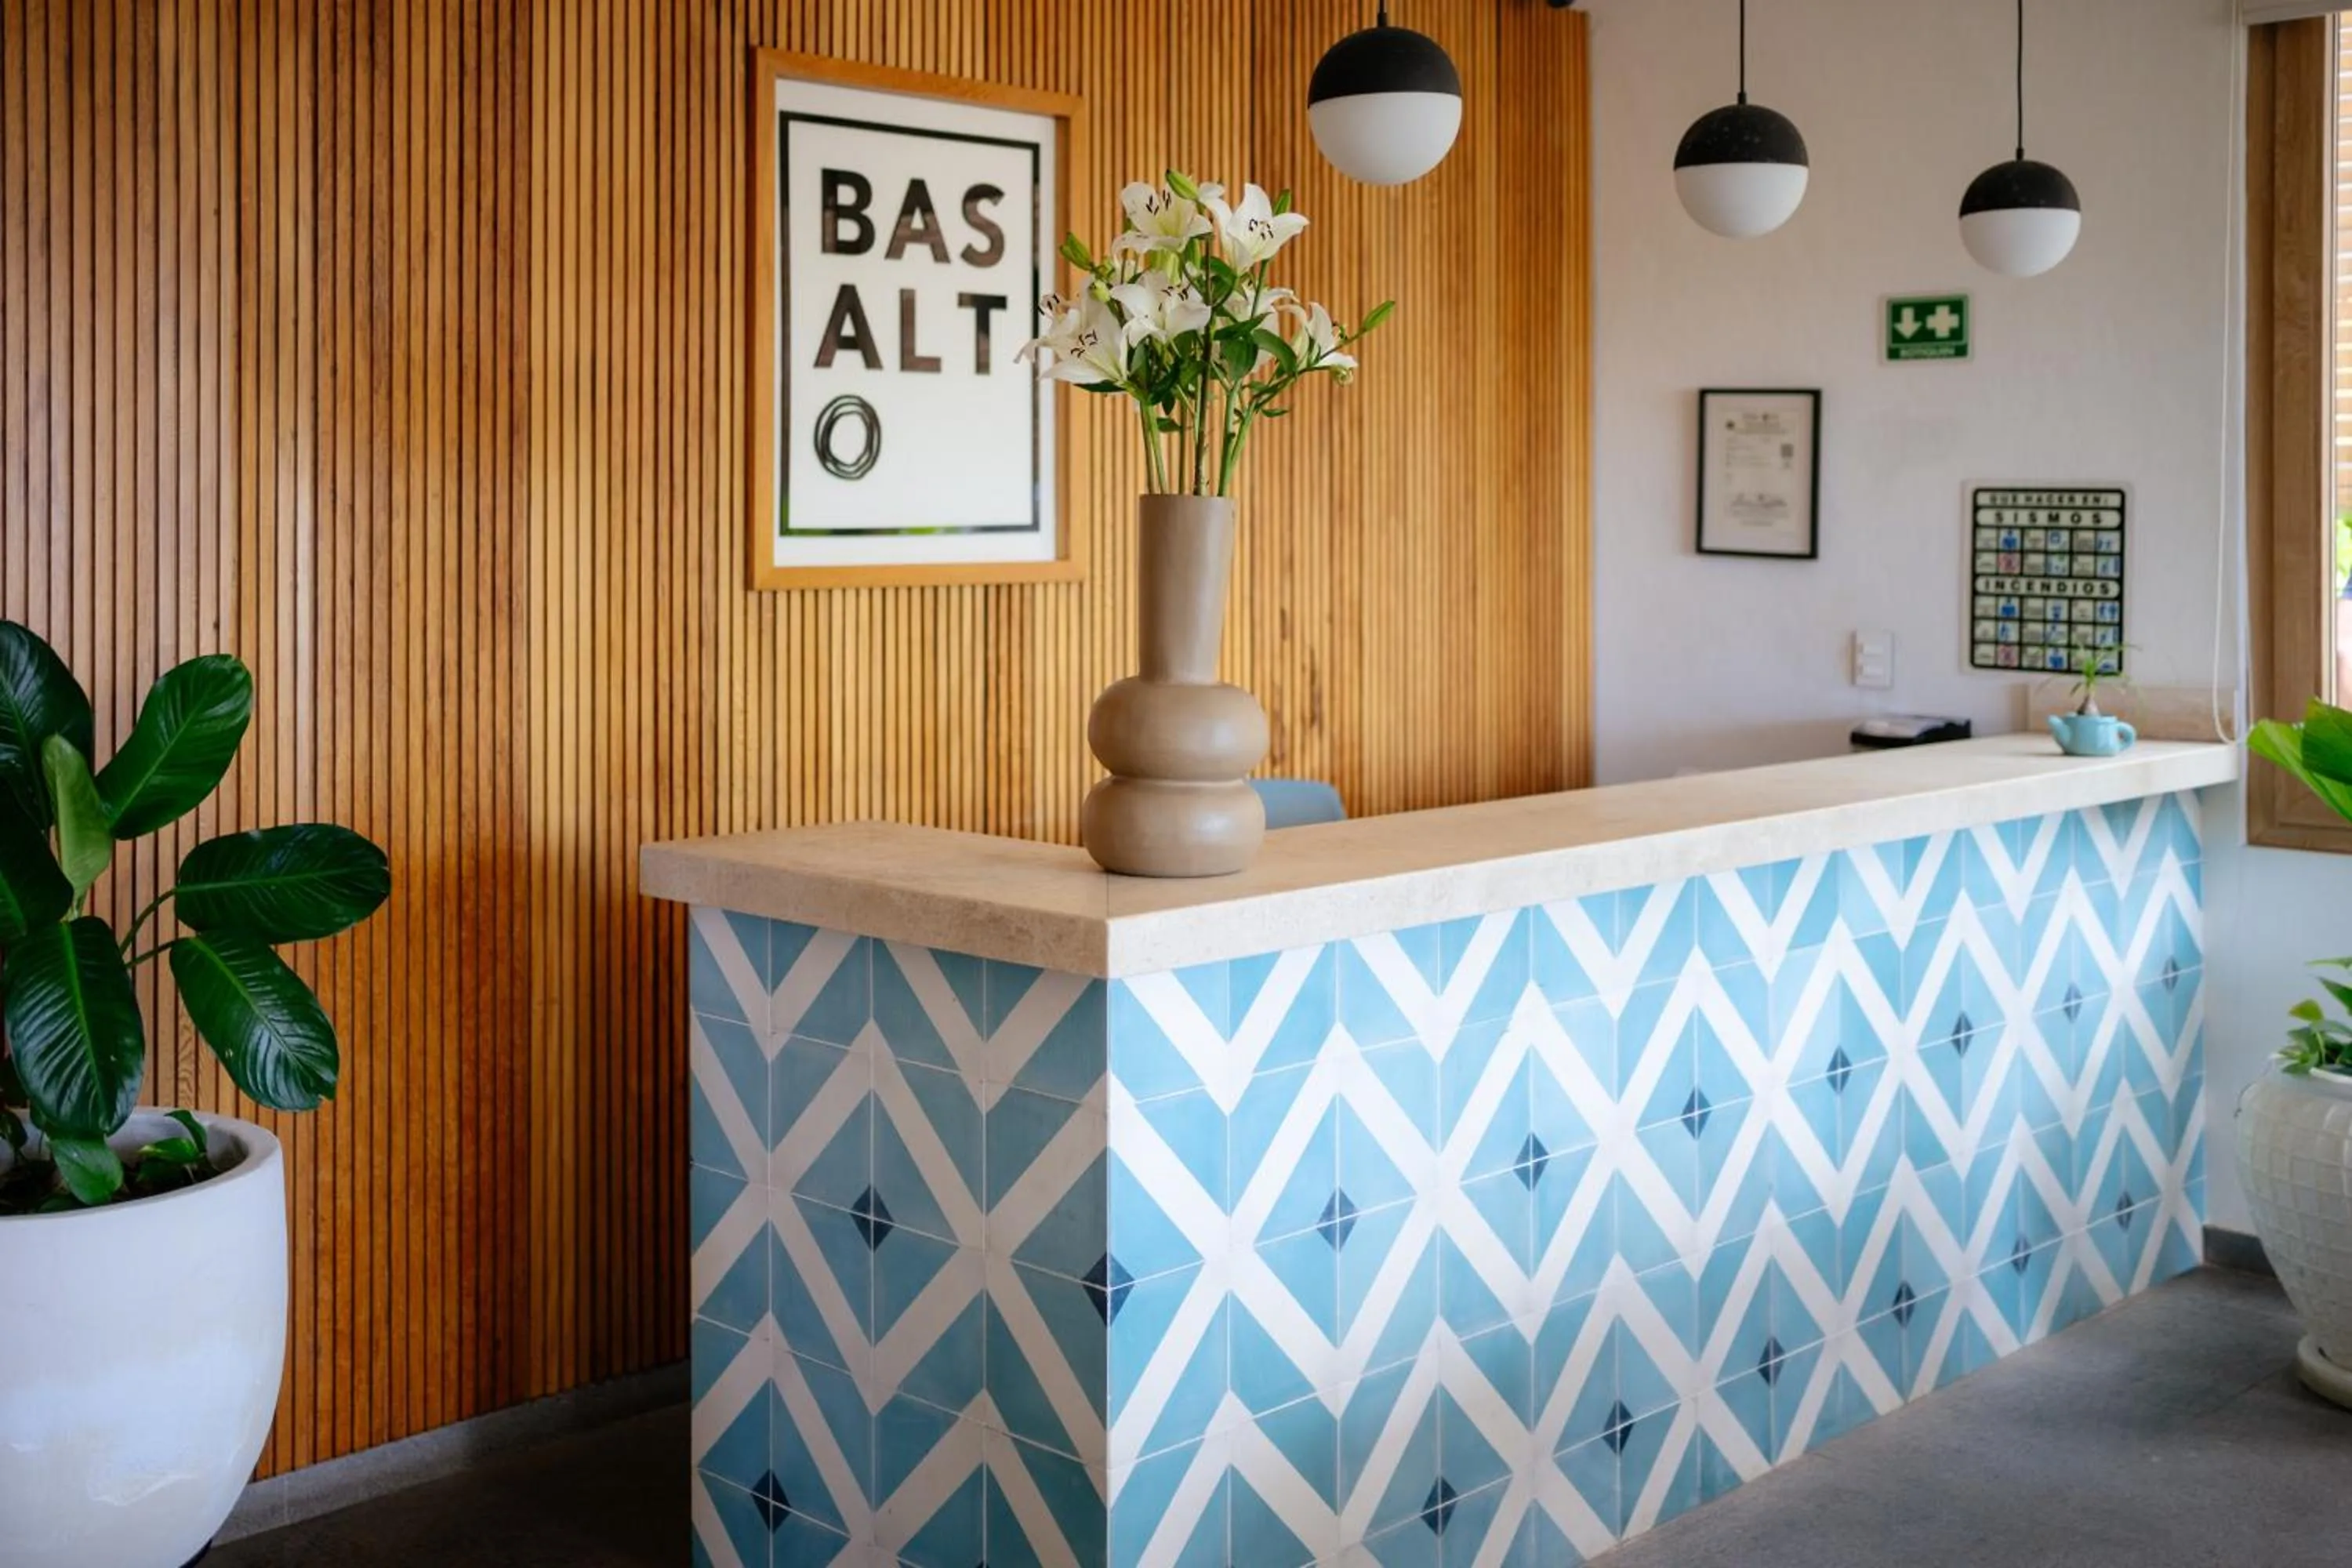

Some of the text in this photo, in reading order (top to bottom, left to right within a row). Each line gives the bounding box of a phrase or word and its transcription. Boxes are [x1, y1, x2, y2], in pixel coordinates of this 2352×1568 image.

[820, 167, 1007, 268] BAS
[813, 283, 1007, 376] ALT
[813, 394, 883, 481] O
[1994, 511, 2103, 525] SISMOS
[1984, 579, 2111, 595] INCENDIOS
